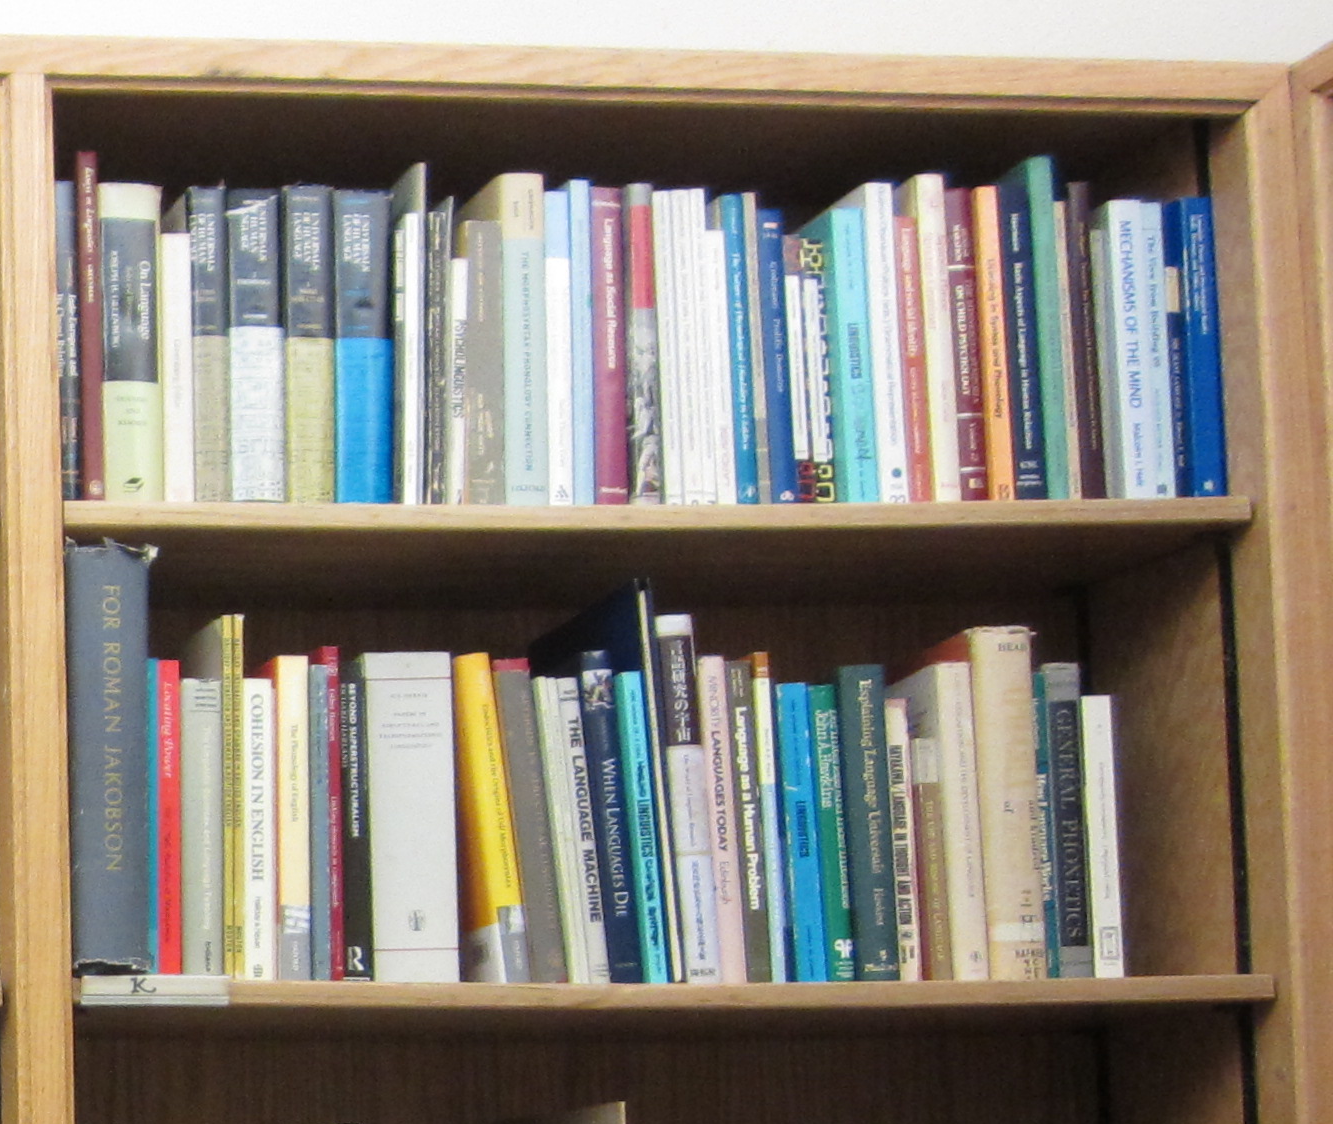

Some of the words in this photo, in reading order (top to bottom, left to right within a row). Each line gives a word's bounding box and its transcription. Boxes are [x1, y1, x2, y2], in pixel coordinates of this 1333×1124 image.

[139, 260, 152, 279] On
[1118, 220, 1138, 312] MECHANISMS
[137, 283, 152, 340] Language
[1125, 317, 1138, 335] OF
[1126, 340, 1140, 367] THE
[1127, 371, 1142, 409] MIND
[102, 584, 122, 628] FOR
[103, 642, 123, 733] ROMAN
[250, 694, 265, 781] COHESION
[567, 719, 584, 749] THE
[1056, 709, 1077, 809] GENERAL
[104, 744, 123, 871] JAKOBSON
[250, 784, 264, 805] IN
[573, 754, 594, 842] LANGUAGE
[602, 757, 617, 804] WHEN
[250, 808, 265, 881] ENGLISH
[606, 807, 625, 888] LANGUAGES
[583, 849, 602, 923] MACHINE
[1059, 820, 1082, 938] PHONETICS
[130, 977, 157, 994] K
